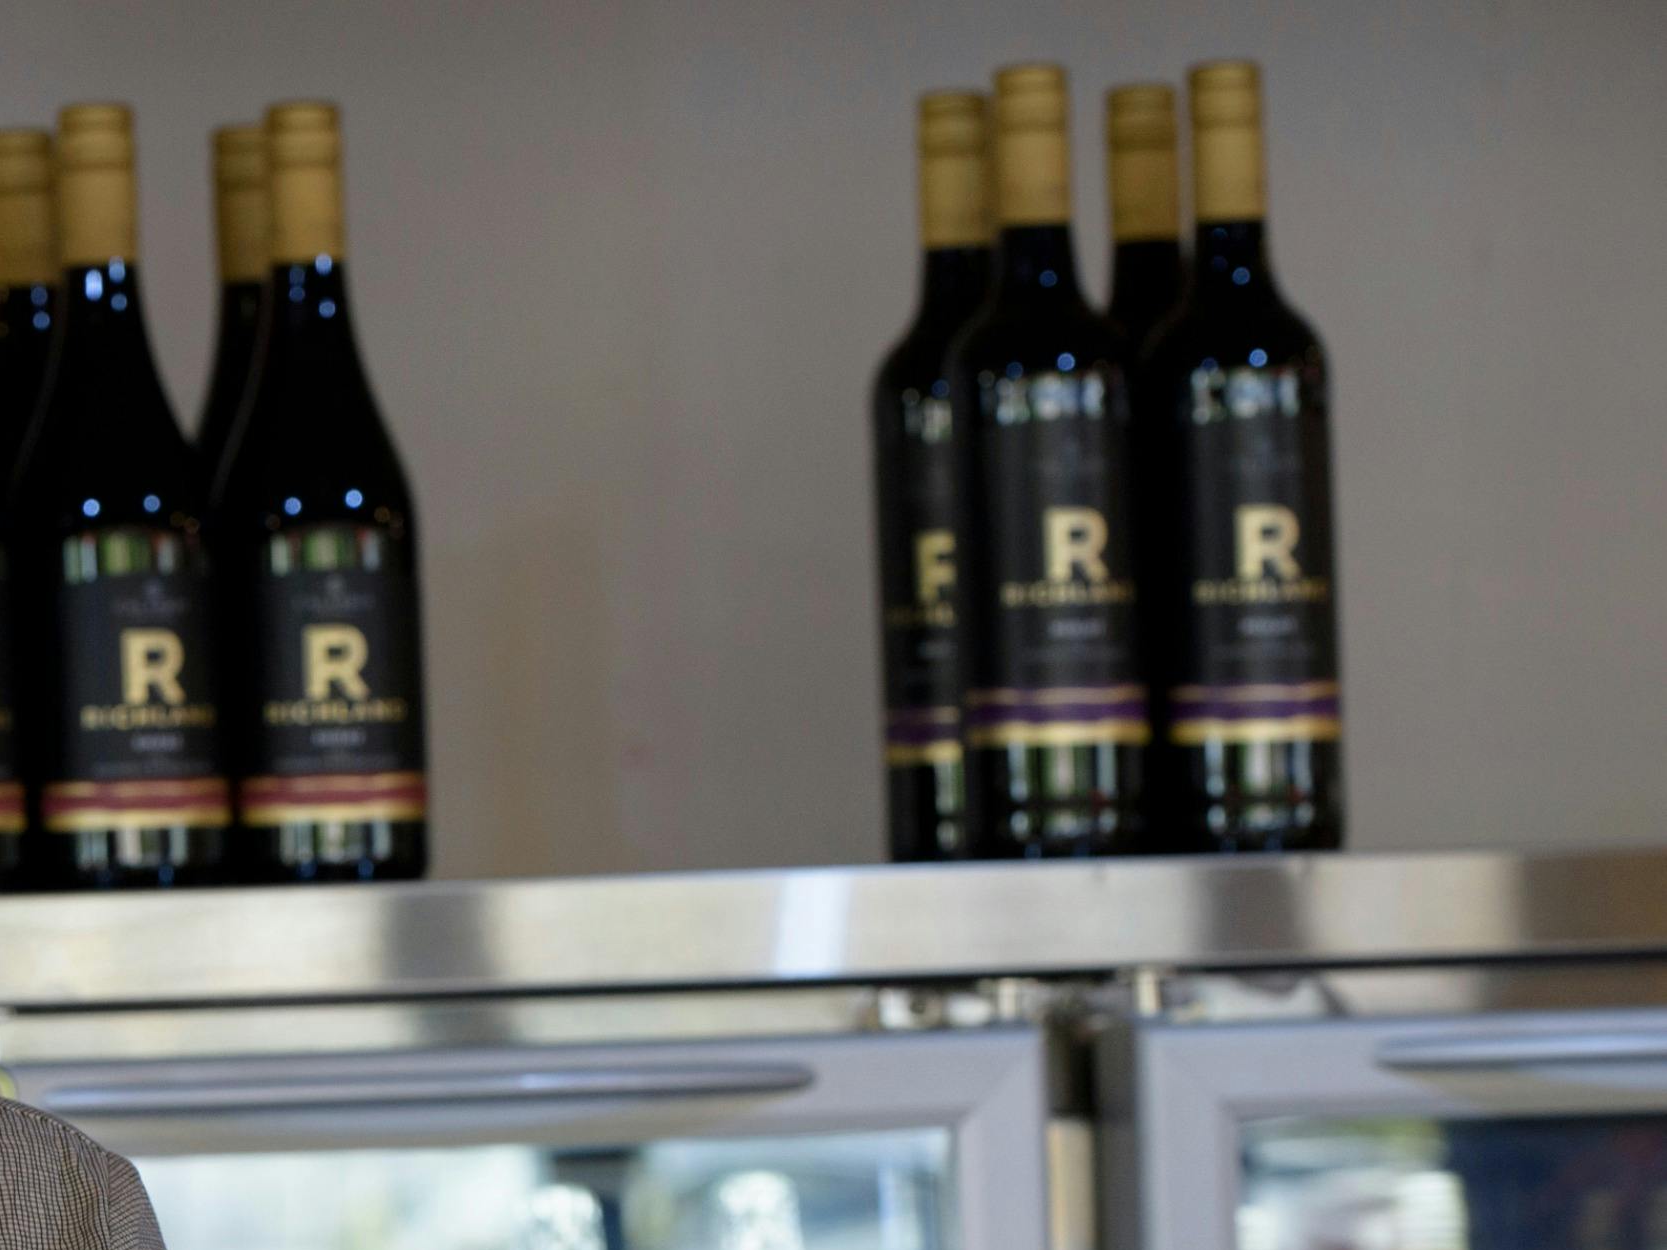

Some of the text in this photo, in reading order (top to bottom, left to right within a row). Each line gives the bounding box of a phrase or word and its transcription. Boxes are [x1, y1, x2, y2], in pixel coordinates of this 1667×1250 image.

[1045, 505, 1109, 580] R
[1236, 504, 1300, 579] R
[121, 628, 185, 704] R
[304, 624, 370, 700] R
